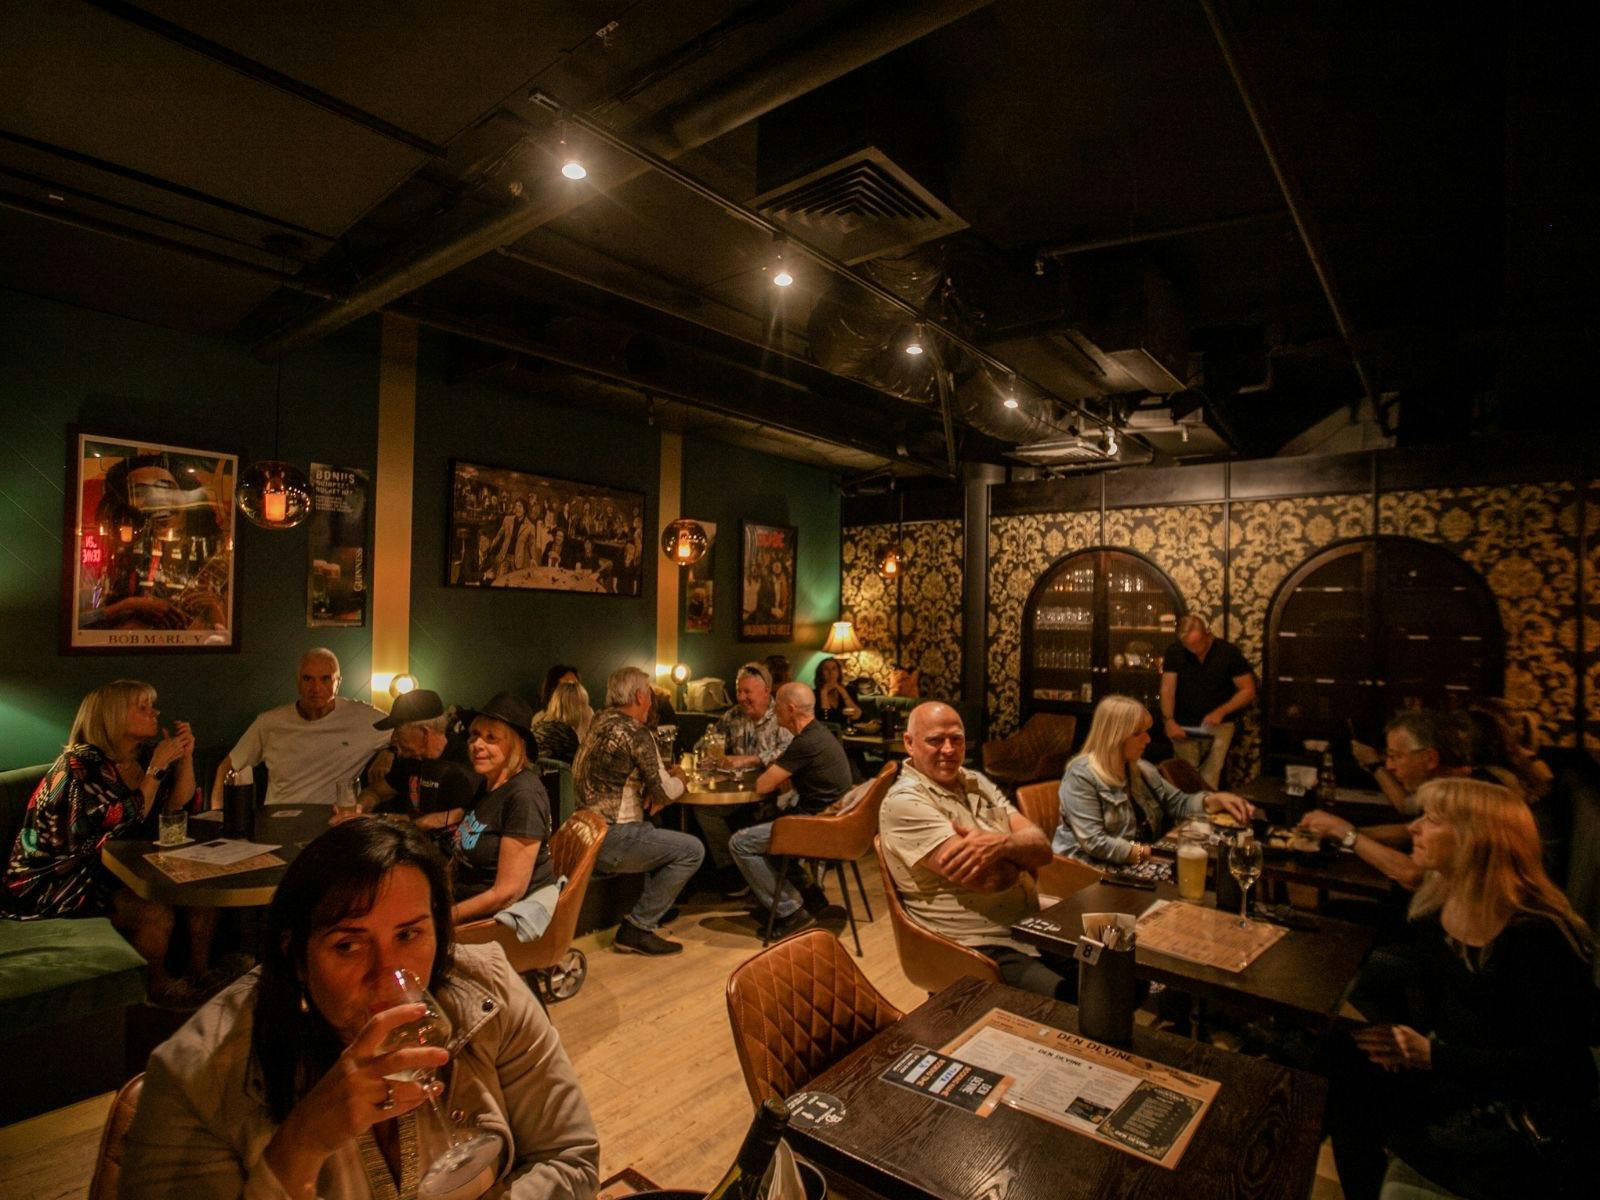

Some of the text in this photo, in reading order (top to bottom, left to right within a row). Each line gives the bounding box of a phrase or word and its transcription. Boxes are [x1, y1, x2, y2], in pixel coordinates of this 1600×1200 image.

[108, 634, 202, 644] BOB MARLY
[1082, 944, 1093, 958] 8
[1056, 1032, 1084, 1045] DEN
[1086, 1043, 1134, 1061] DEVINE
[1038, 1048, 1054, 1058] DEN
